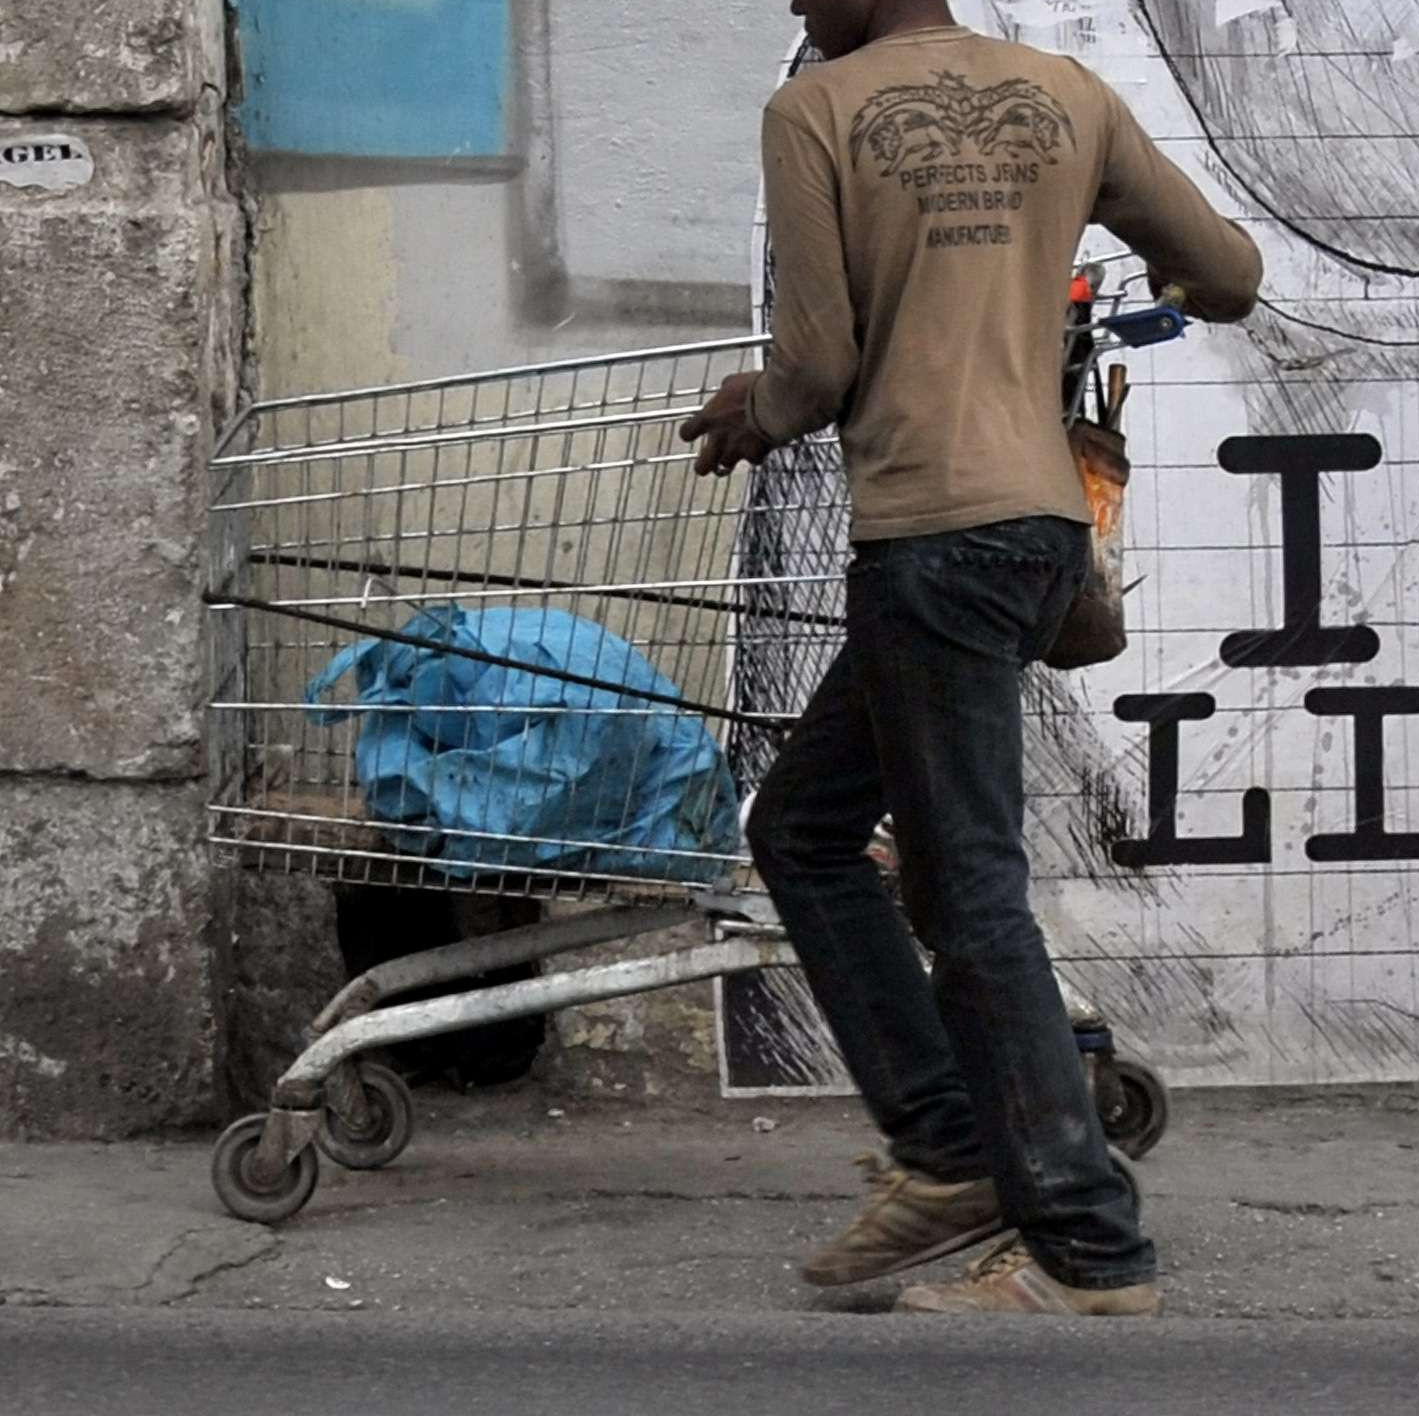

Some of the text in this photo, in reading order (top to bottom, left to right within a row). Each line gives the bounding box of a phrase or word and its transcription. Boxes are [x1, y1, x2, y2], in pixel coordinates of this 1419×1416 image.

[0, 143, 83, 164] GEL
[916, 190, 1023, 216] MDERN BRD
[1217, 431, 1382, 667] I
